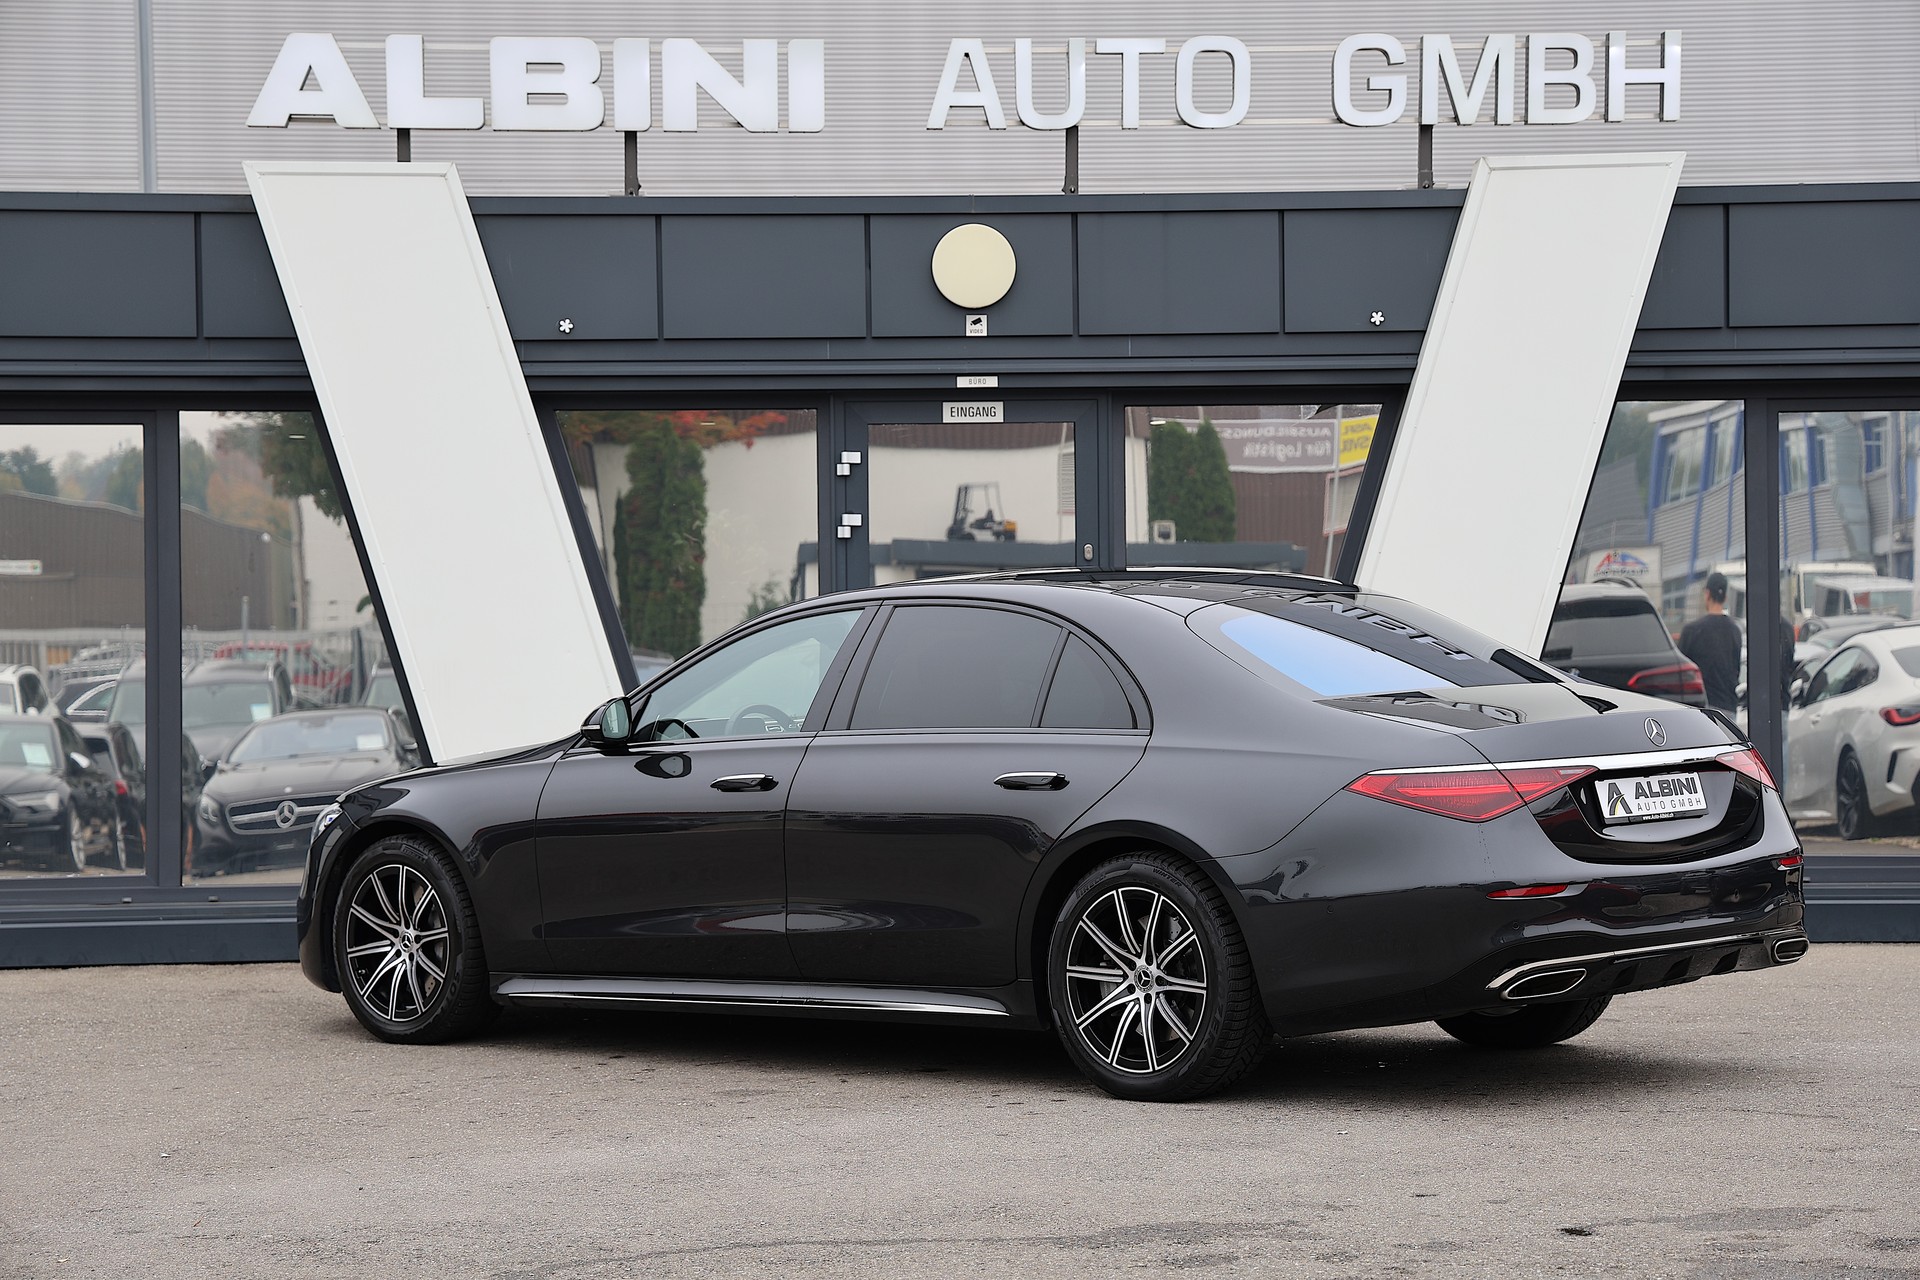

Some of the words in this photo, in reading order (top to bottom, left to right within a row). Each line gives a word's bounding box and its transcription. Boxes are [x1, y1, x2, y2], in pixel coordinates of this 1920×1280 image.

[246, 32, 825, 133] ALBINI
[926, 35, 1251, 130] AUTO
[1331, 29, 1684, 126] GMBH
[968, 377, 987, 385] BÜRO
[950, 406, 997, 418] EINGANG
[1634, 777, 1698, 800] ALBINI
[1637, 800, 1666, 812] AUTO
[1670, 798, 1702, 809] GMBH
